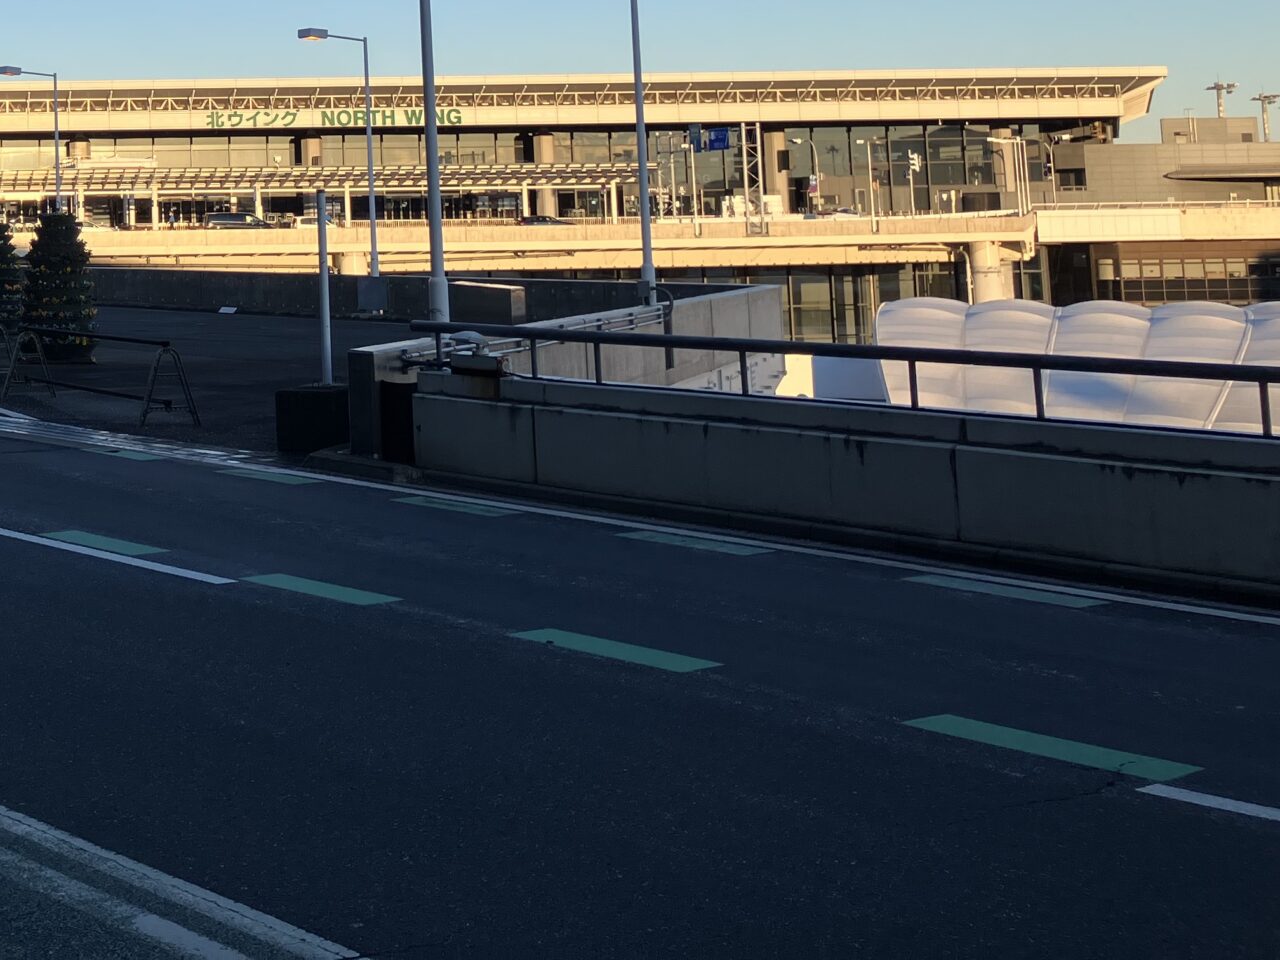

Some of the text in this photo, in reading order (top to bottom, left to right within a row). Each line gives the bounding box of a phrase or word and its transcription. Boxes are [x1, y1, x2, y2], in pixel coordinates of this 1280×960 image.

[206, 109, 299, 128] 北ウイング
[321, 109, 462, 126] NORTH WNG
